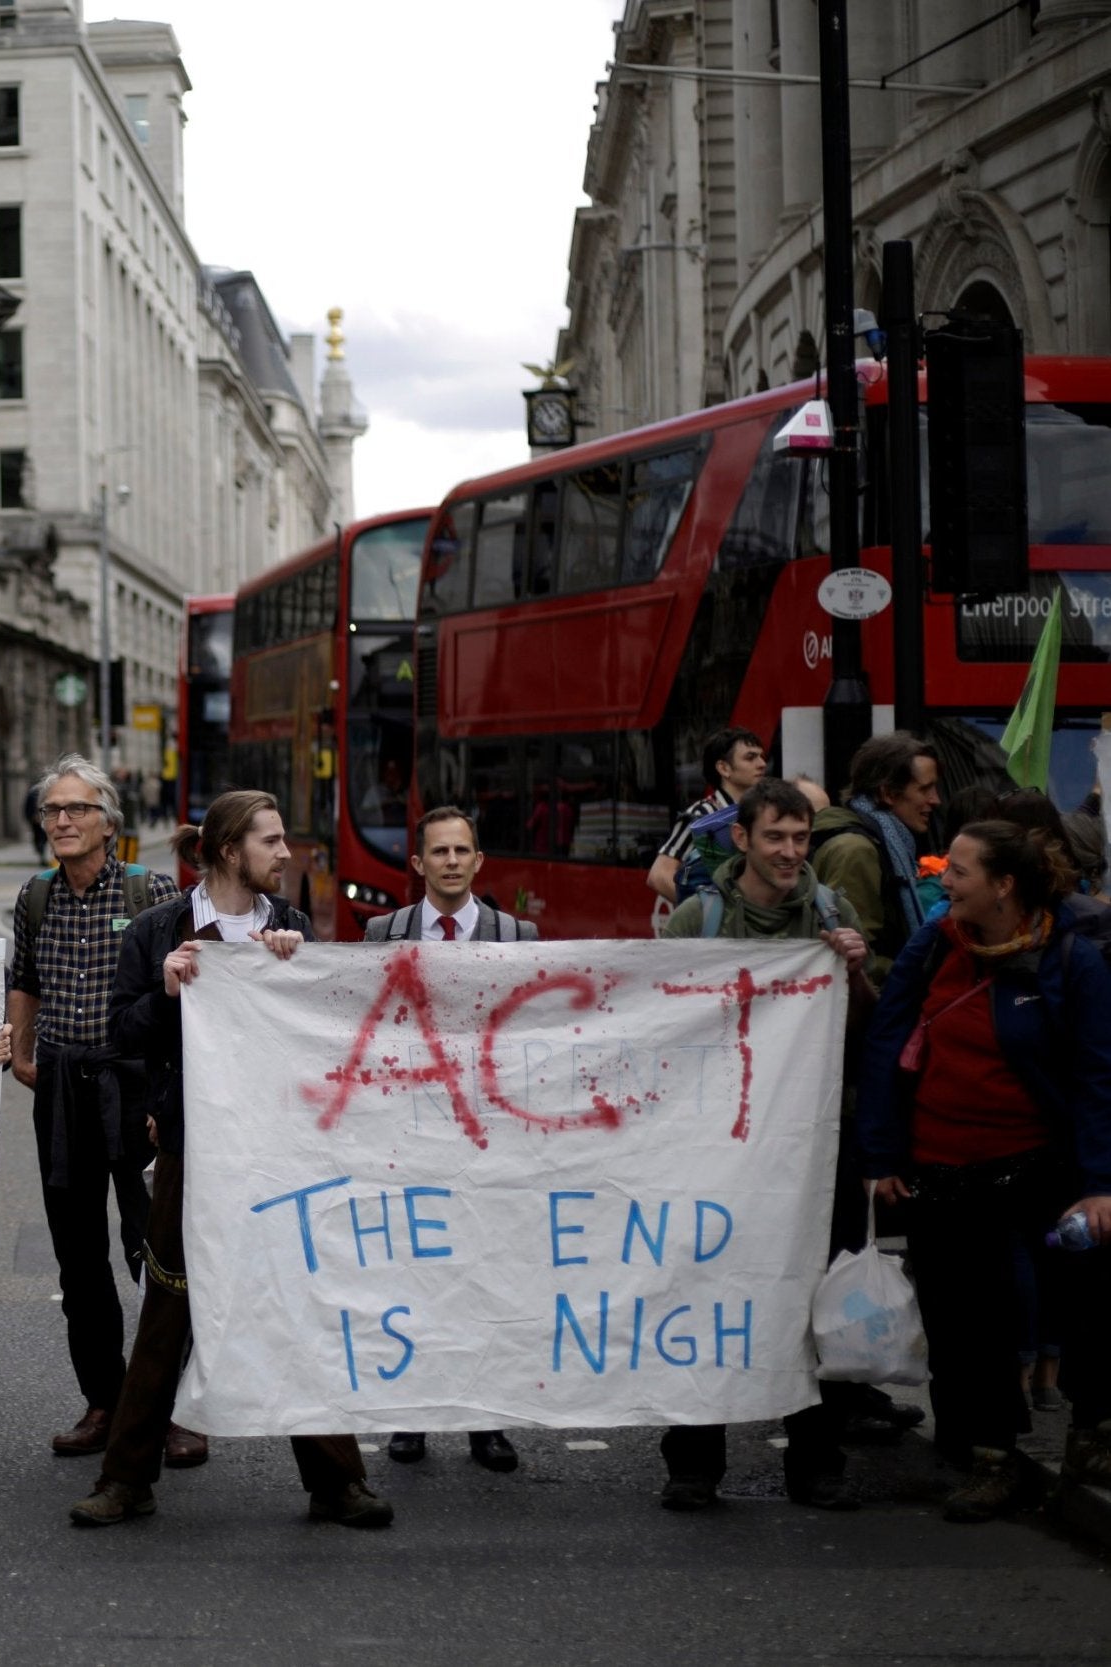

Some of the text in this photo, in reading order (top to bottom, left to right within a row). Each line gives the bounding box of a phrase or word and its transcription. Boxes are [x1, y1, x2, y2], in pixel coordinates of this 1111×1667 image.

[962, 593, 1111, 627] Liverpoo Stre
[299, 946, 834, 1151] ACT
[250, 1174, 733, 1275] THE END
[339, 1291, 752, 1392] IS NIGH
